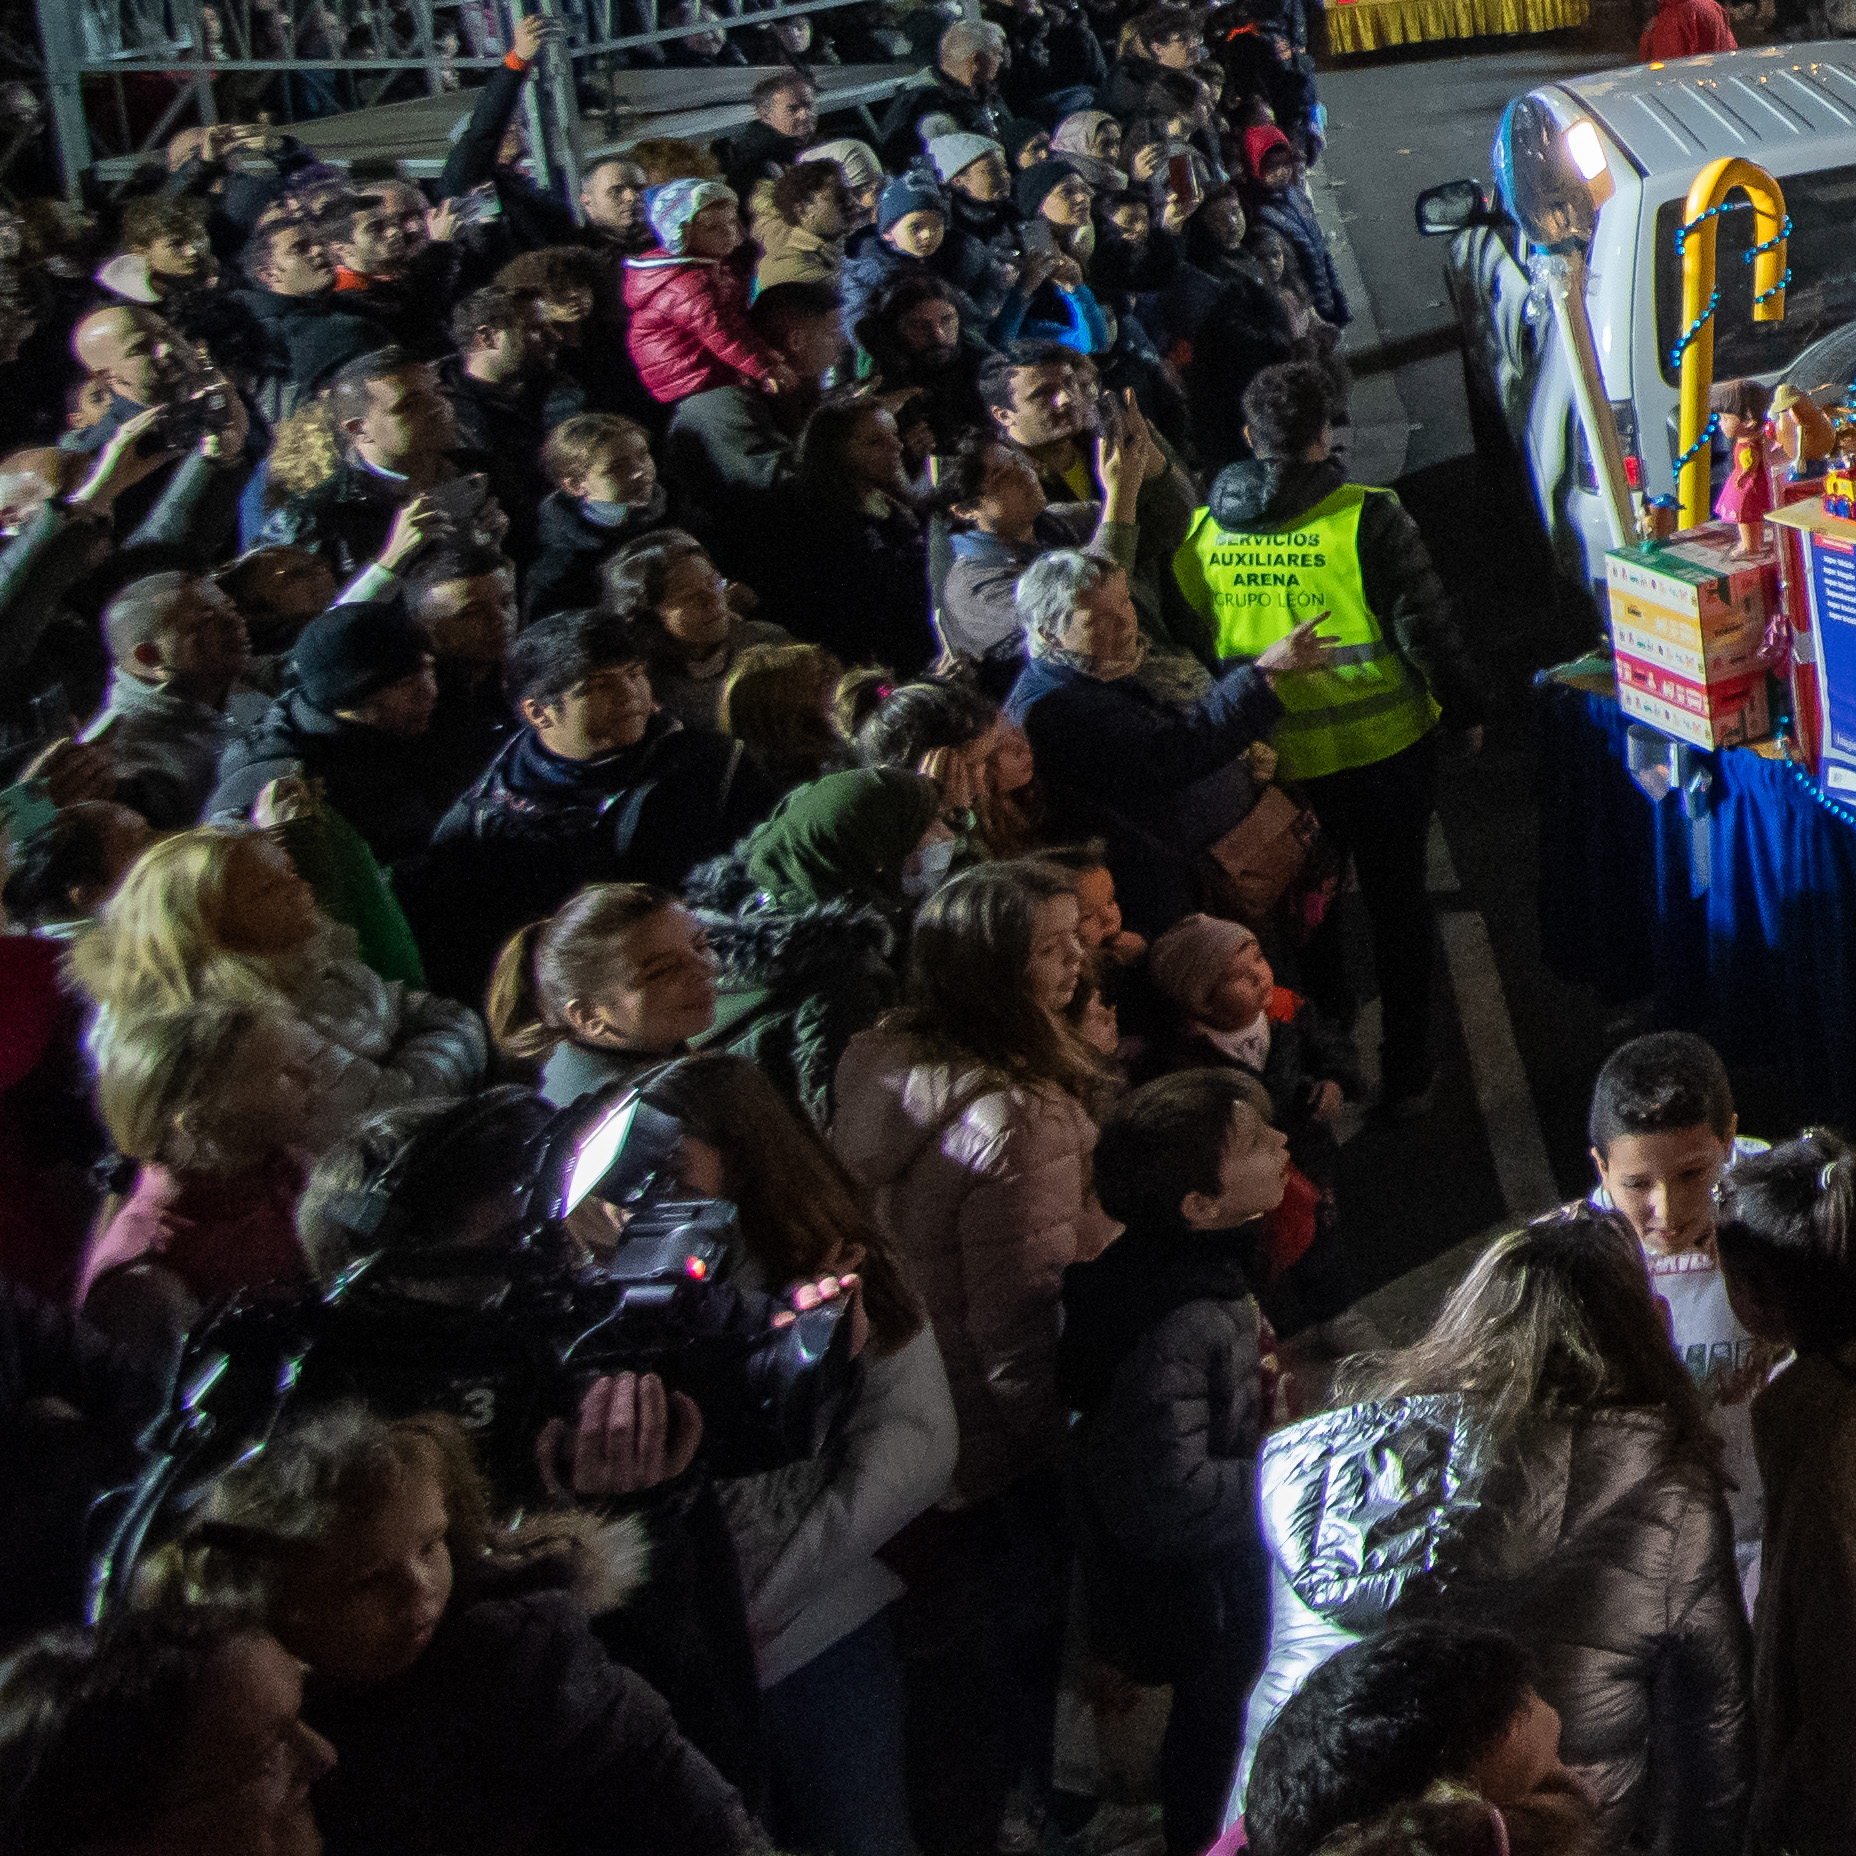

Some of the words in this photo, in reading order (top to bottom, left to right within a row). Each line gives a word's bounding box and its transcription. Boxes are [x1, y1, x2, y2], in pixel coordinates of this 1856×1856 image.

[1210, 552, 1326, 567] AUXILIARES
[1234, 573, 1300, 586] ARENA
[1215, 593, 1271, 607] GRUPO
[1279, 590, 1325, 607] LEÓN
